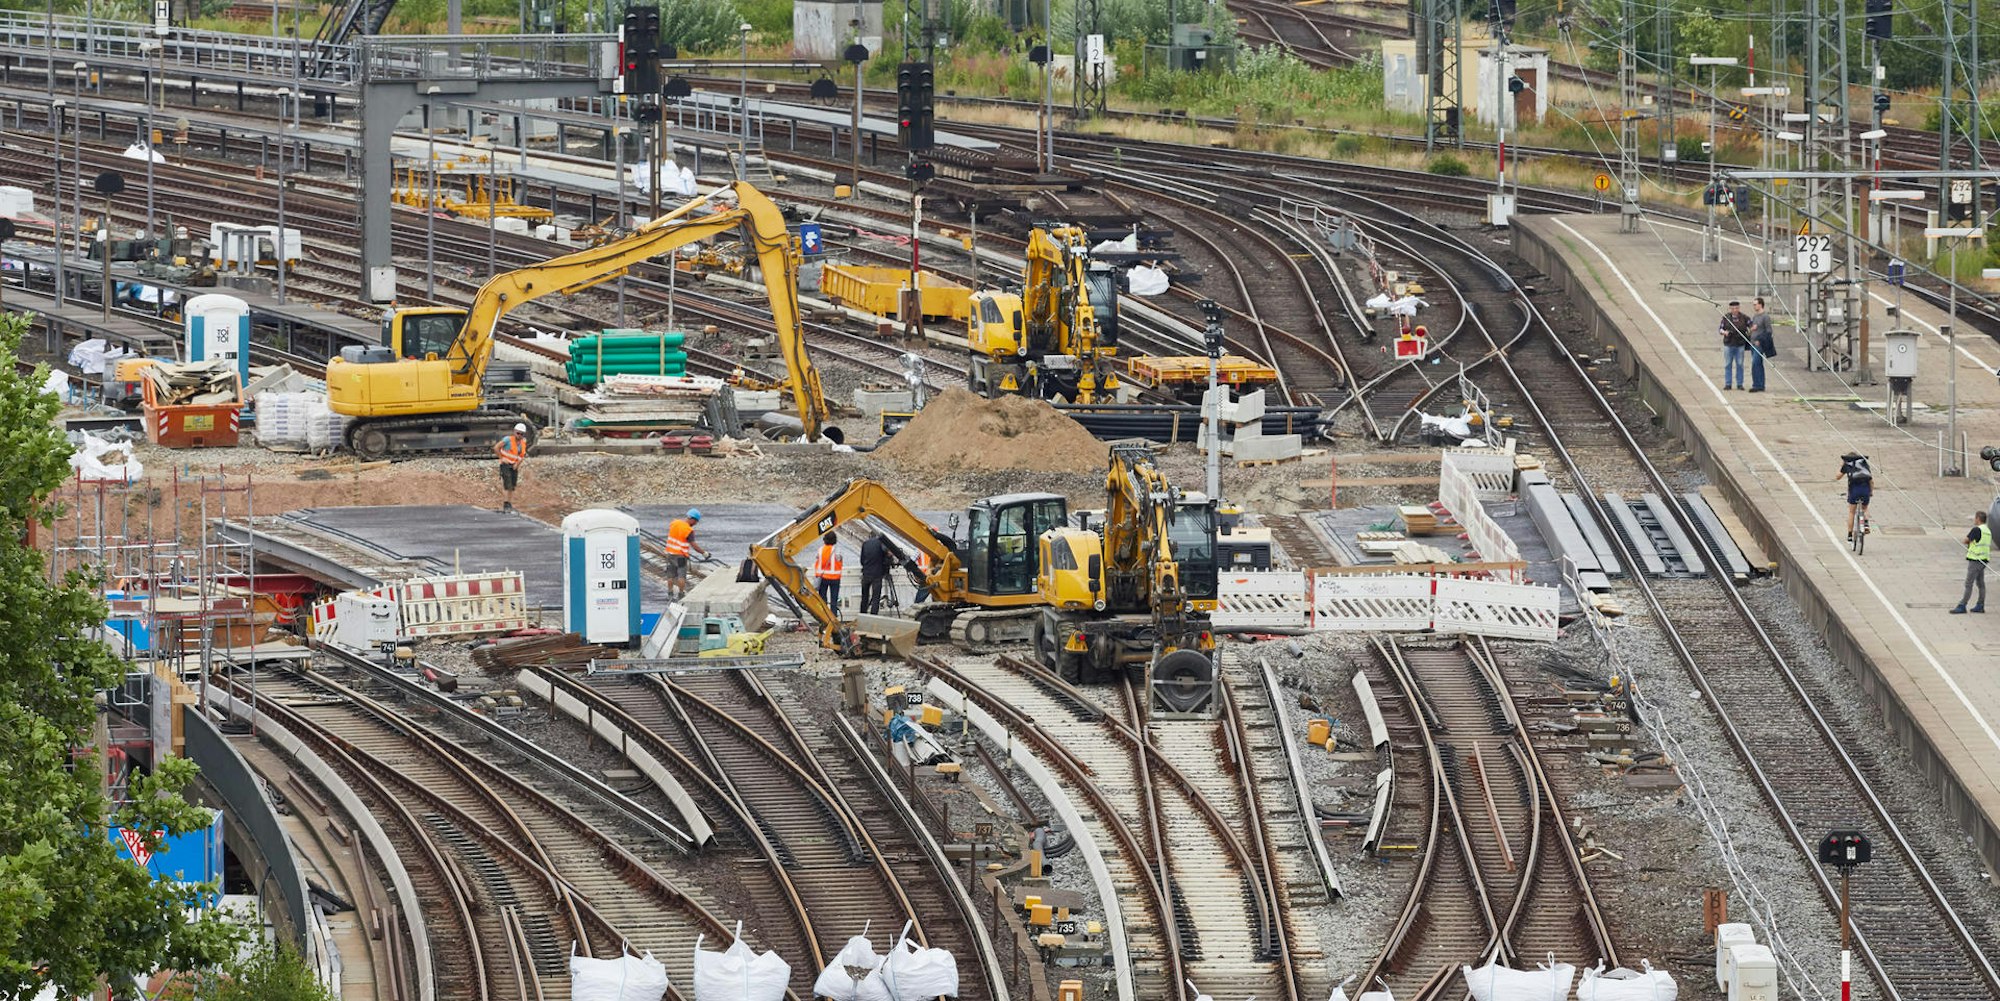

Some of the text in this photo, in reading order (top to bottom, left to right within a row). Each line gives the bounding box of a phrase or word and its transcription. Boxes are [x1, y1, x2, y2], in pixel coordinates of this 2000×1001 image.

[157, 2, 167, 17] H
[1093, 37, 1098, 48] 1
[1092, 48, 1099, 60] 2
[1952, 181, 1971, 191] 292
[1797, 236, 1831, 252] 292
[1809, 253, 1819, 269] 8
[819, 515, 833, 532] CAT
[382, 642, 395, 651] 741
[907, 694, 922, 703] 738
[1611, 701, 1627, 710] 740
[1615, 723, 1630, 732] 736
[976, 825, 992, 834] 737
[1058, 923, 1074, 933] 735
